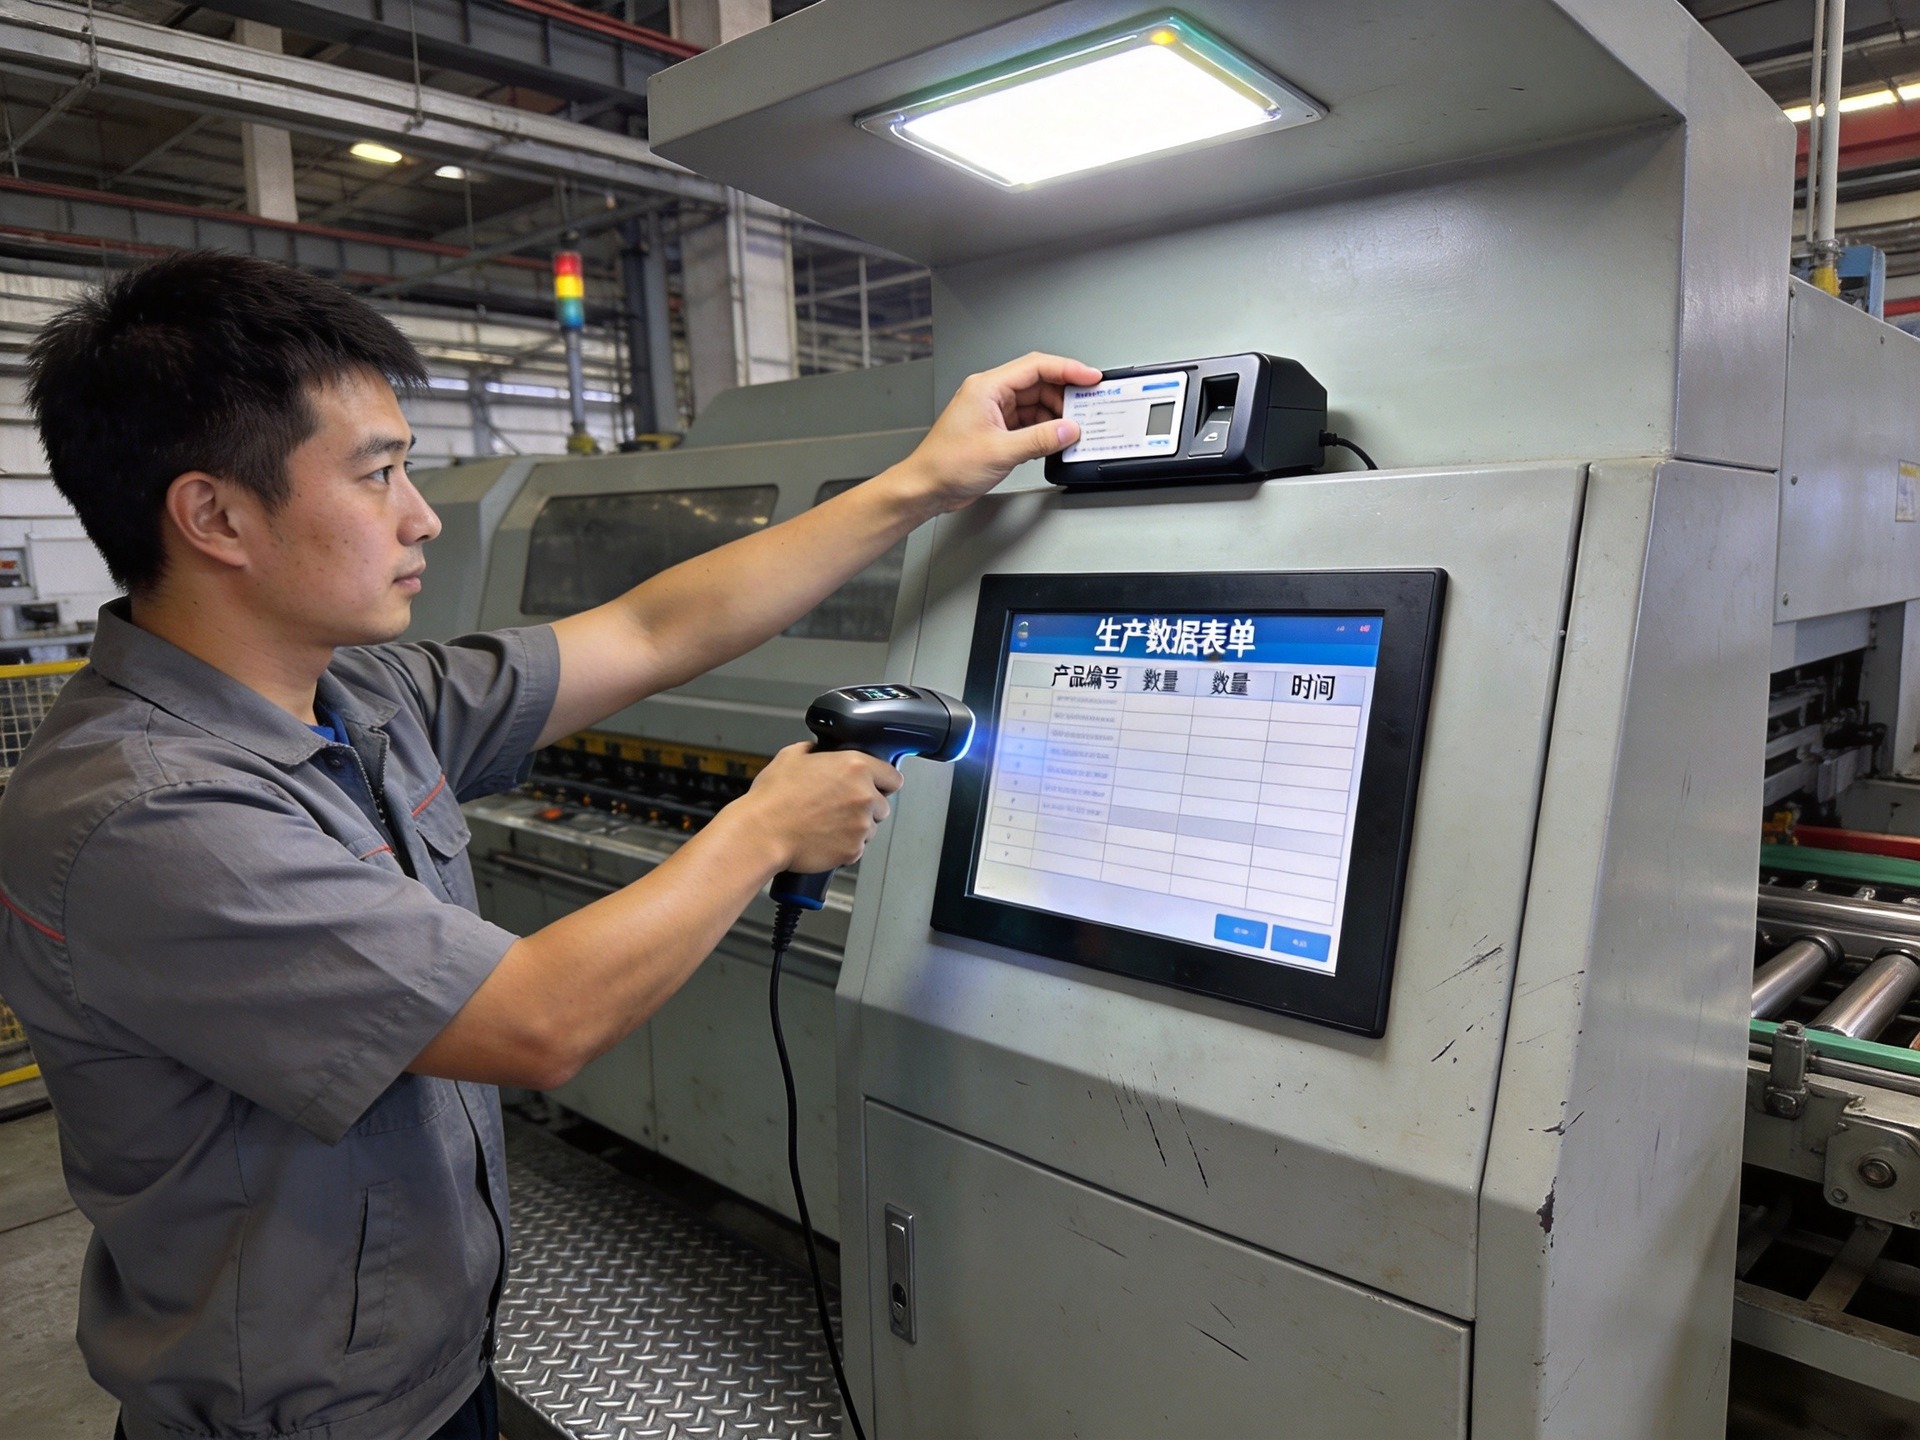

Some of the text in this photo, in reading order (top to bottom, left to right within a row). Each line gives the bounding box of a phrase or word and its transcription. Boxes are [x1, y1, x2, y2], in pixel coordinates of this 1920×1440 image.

[1094, 617, 1256, 658] 生产数据表单
[1142, 668, 1179, 693] 数量
[1291, 673, 1336, 700] 时间
